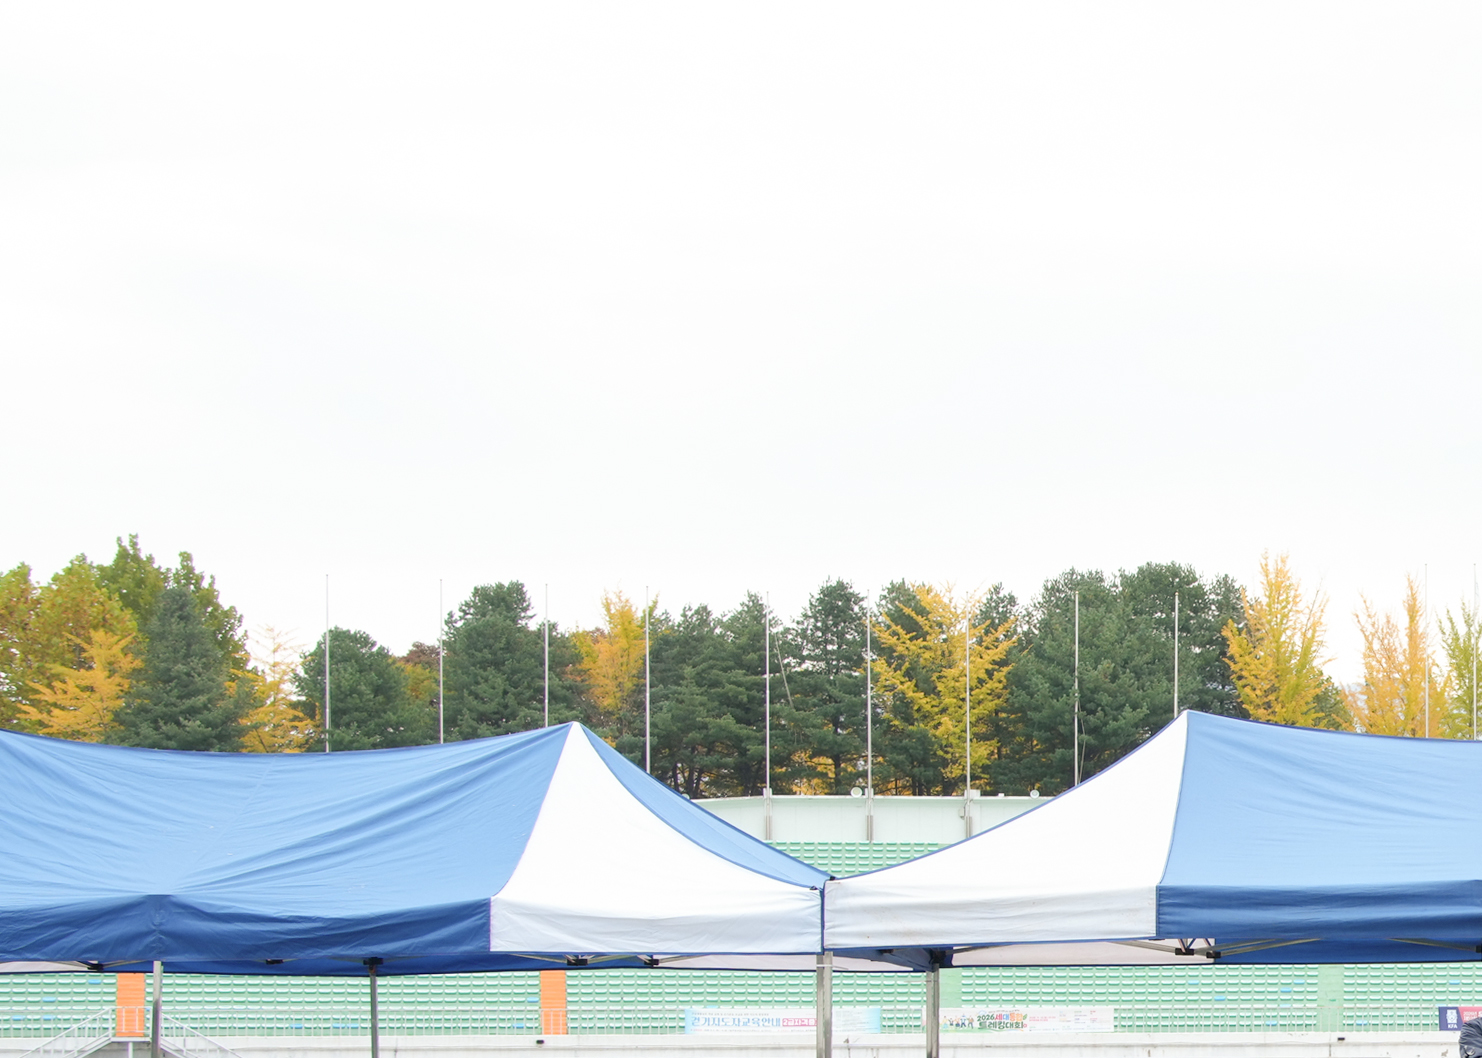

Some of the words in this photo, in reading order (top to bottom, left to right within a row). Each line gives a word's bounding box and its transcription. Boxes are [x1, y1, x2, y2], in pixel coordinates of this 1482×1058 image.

[977, 1013, 994, 1021] 2026
[691, 1017, 780, 1027] 걷기지도자교육안내
[978, 1021, 1023, 1030] 트레킹대회
